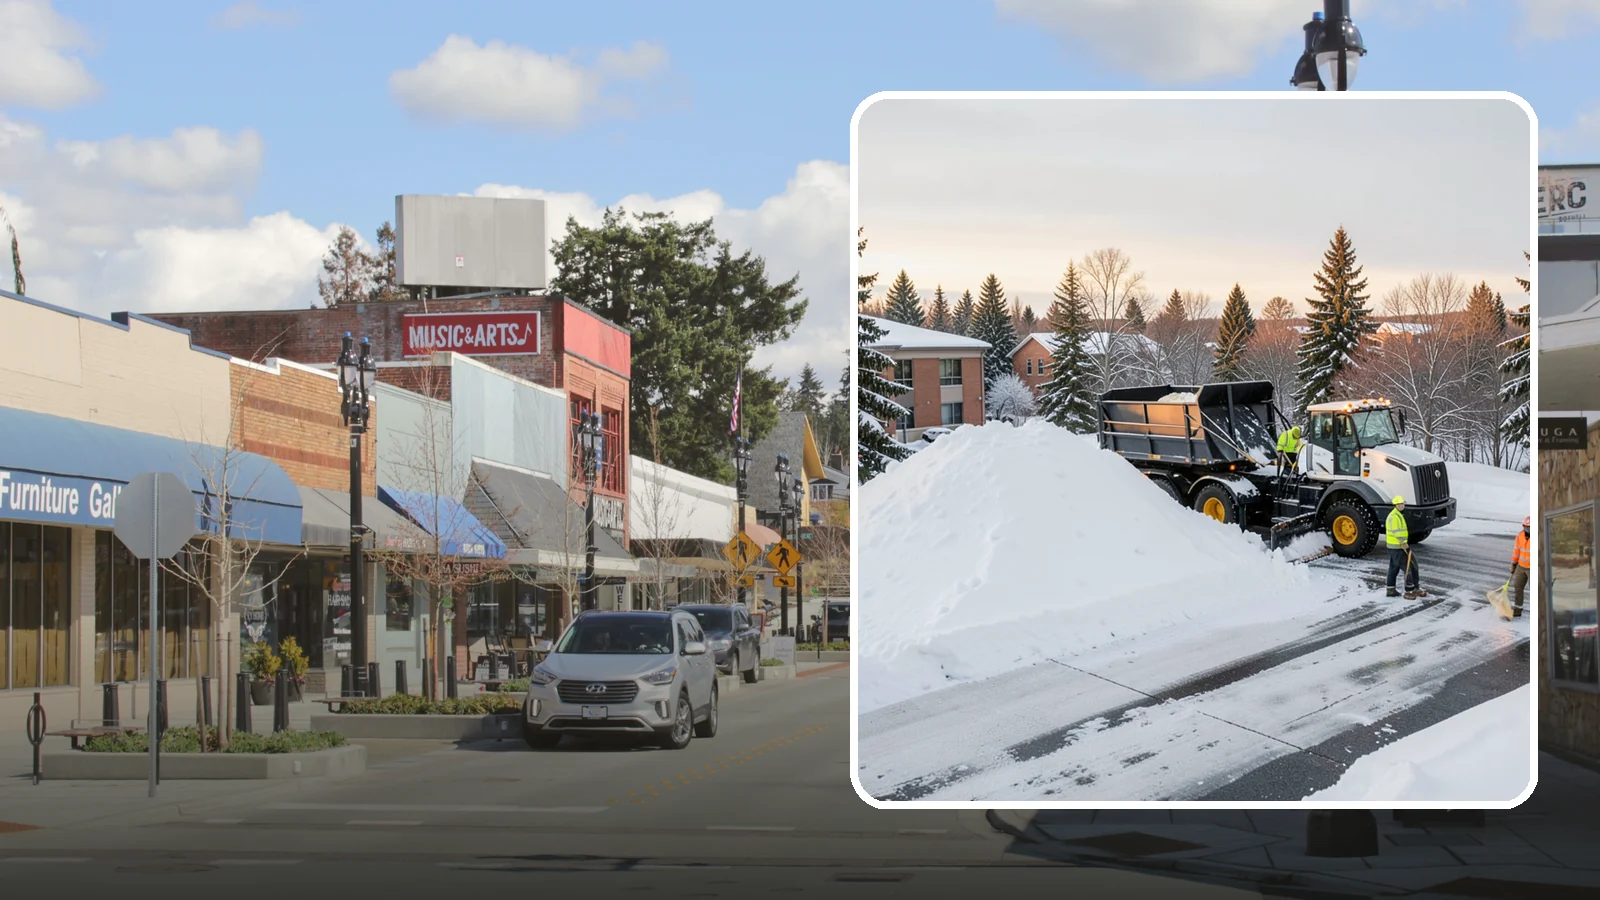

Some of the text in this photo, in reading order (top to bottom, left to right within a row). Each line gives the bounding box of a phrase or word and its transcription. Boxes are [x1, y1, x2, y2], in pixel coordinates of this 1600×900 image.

[409, 323, 519, 349] MUSIC&ARTS
[0, 471, 122, 519] Furniture Gal
[453, 563, 480, 574] SUSHI
